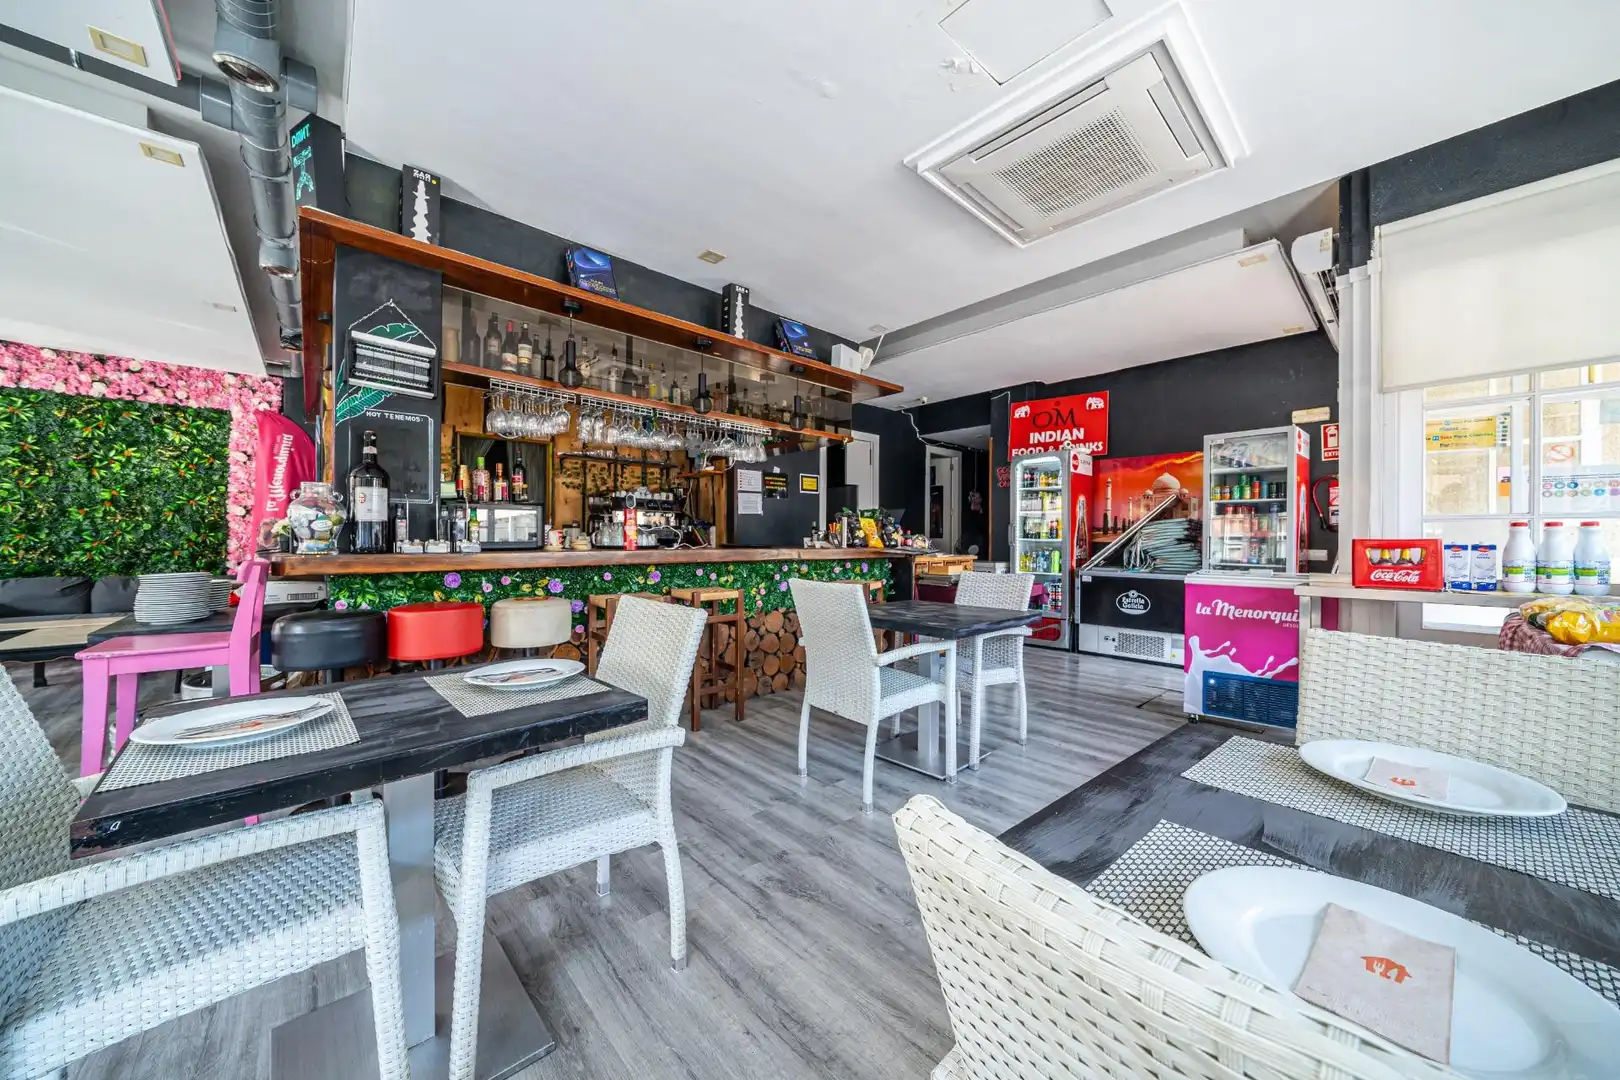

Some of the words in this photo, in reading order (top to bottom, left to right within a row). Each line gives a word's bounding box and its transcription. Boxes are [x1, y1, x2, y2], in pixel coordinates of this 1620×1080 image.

[1032, 407, 1077, 429] OM
[1029, 427, 1084, 444] INDIAN
[1012, 446, 1044, 457] FOOD
[1370, 568, 1422, 584] Coca-Cola
[1121, 596, 1145, 604] Estrella
[1122, 602, 1144, 610] Galicia
[1196, 602, 1211, 615] la
[1211, 599, 1299, 624] Menorqui
